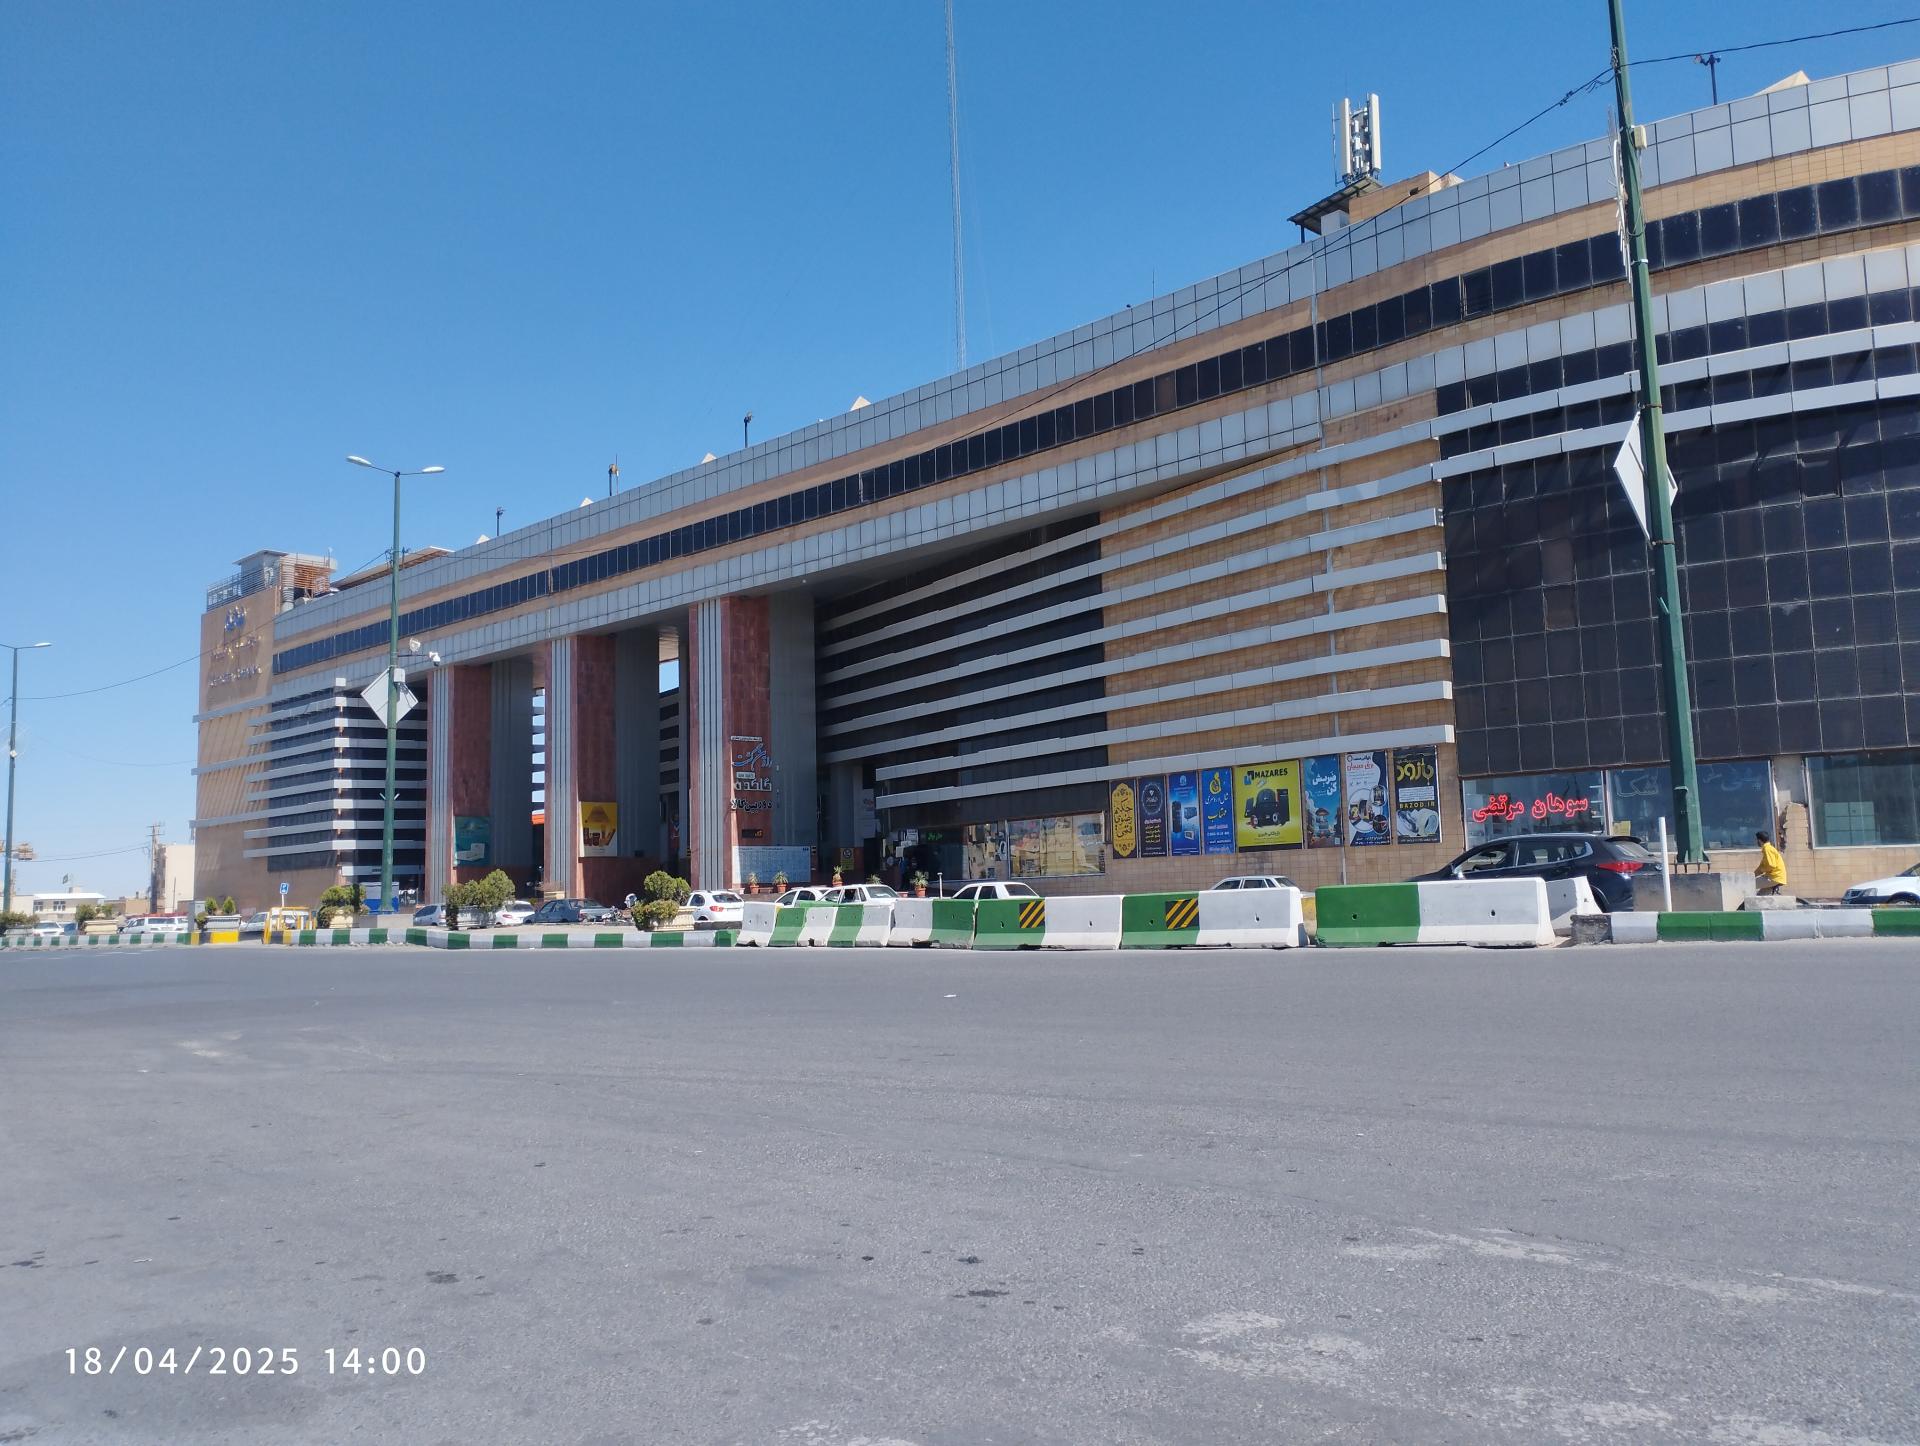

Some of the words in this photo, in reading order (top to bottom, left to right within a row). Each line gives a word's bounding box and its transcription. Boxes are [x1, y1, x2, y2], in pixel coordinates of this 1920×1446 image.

[1254, 767, 1288, 778] MAZARES
[1472, 794, 1525, 822] مرتضی
[1531, 792, 1588, 819] سوهان
